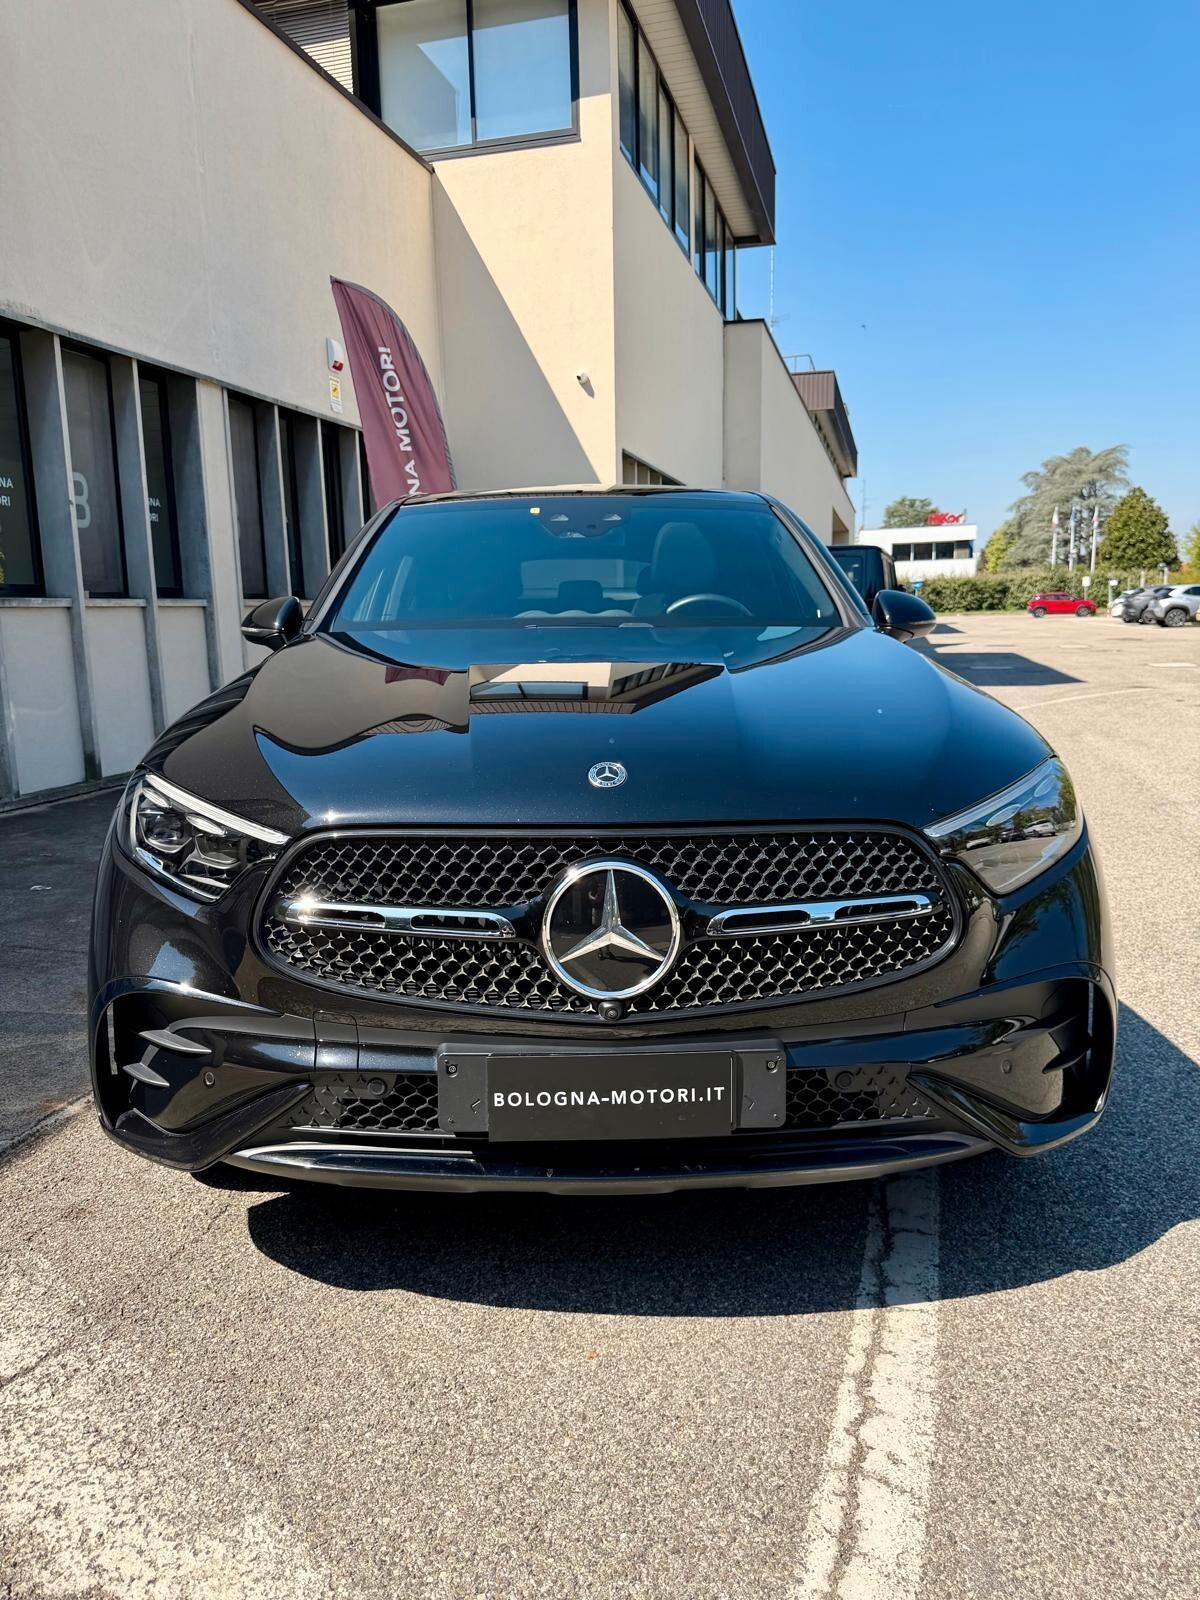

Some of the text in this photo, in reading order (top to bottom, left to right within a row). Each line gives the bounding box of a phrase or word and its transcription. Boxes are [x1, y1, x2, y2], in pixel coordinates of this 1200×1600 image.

[378, 346, 412, 451] MOTORI
[0, 495, 11, 507] RI
[493, 1086, 725, 1107] BOLOGNA-MOTORI.IT
